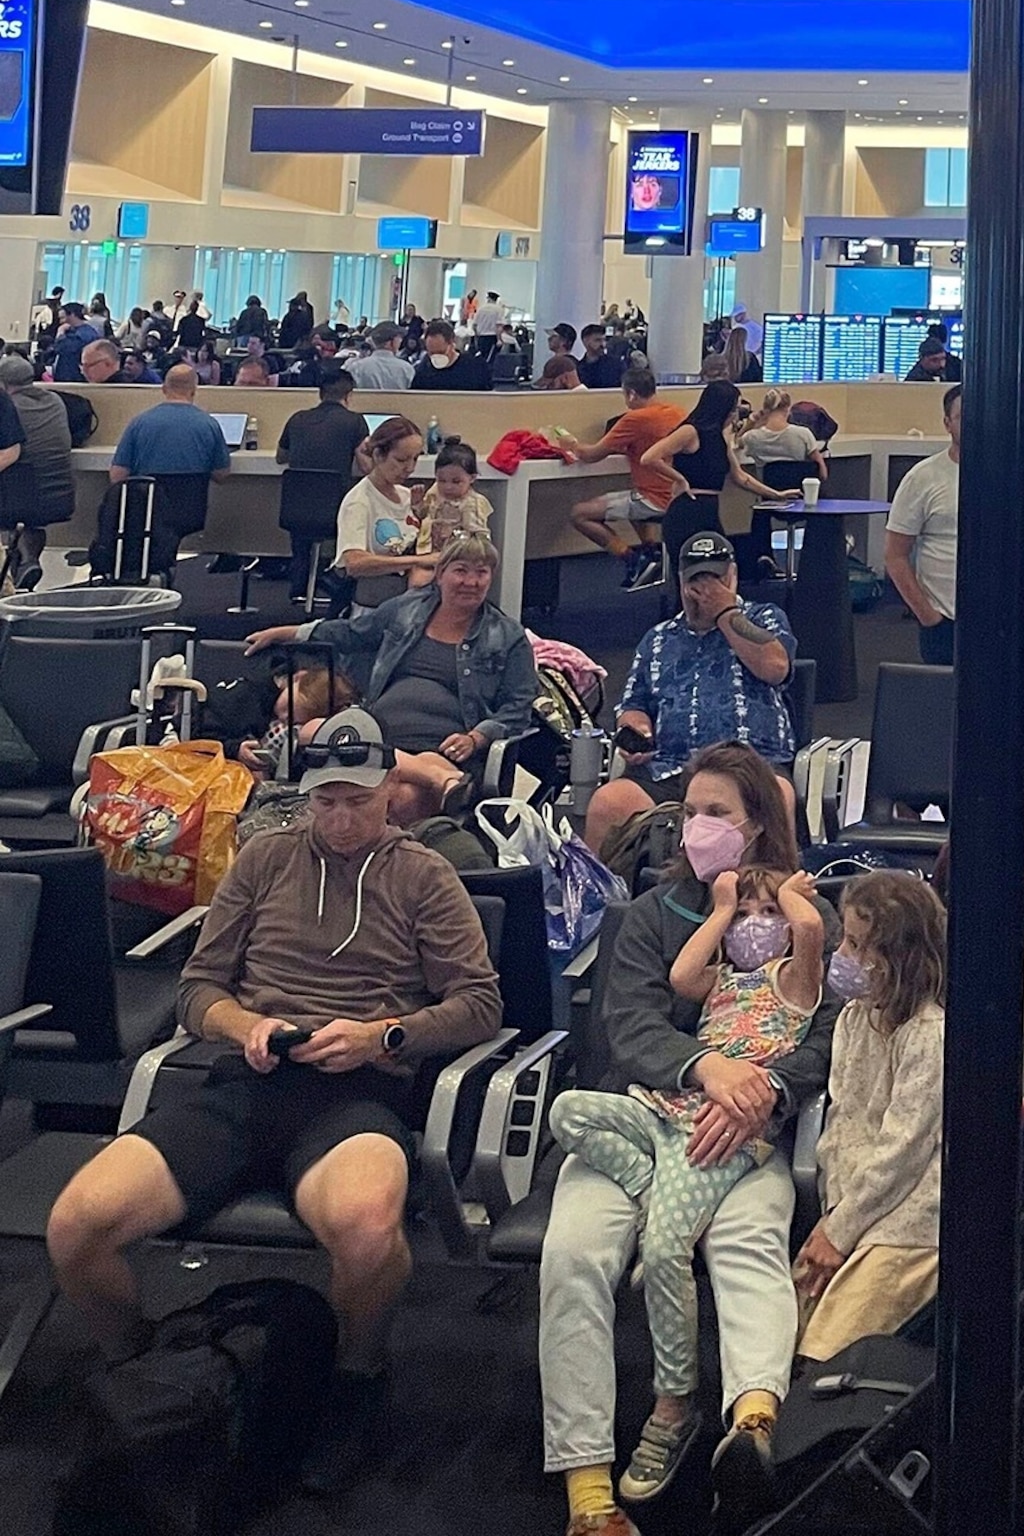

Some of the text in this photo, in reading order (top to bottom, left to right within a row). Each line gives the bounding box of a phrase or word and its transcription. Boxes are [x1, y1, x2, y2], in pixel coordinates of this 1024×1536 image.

[69, 204, 90, 232] 38
[737, 207, 756, 221] 38
[93, 626, 142, 639] BRUT
